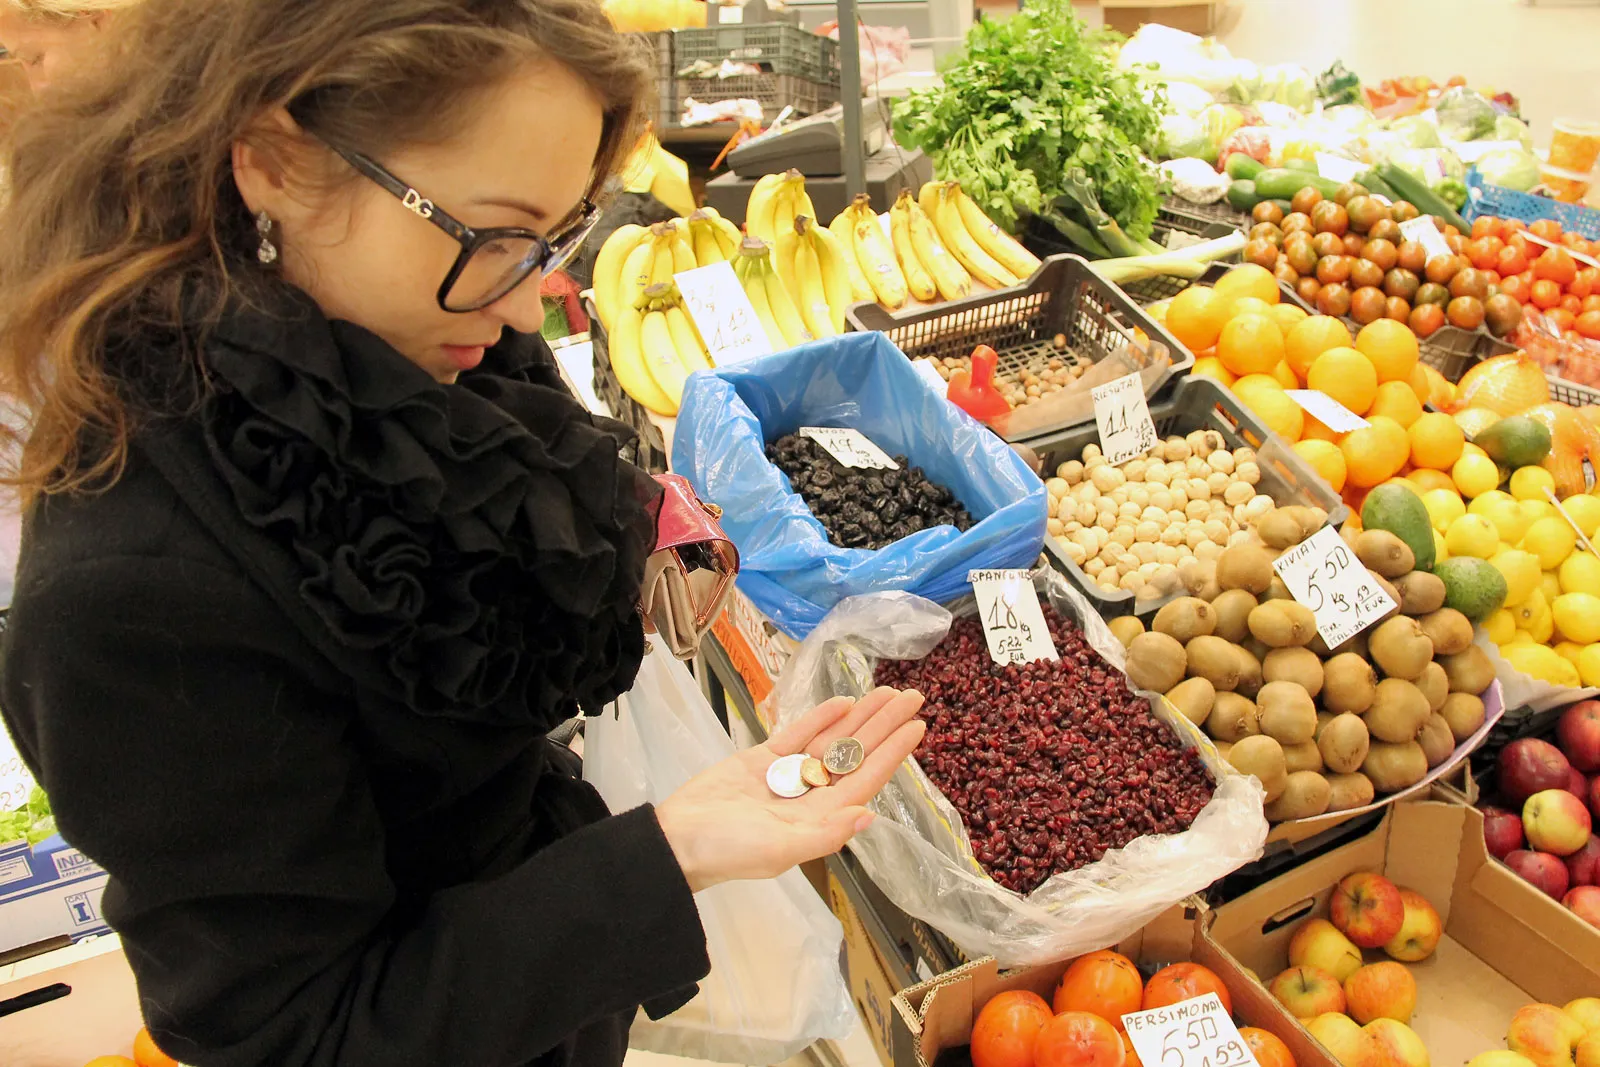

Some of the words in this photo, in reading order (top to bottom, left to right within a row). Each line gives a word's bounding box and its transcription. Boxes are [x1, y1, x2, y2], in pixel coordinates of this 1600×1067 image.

[402, 188, 434, 218] DG
[1277, 540, 1317, 572] KIVIAI
[1365, 596, 1387, 612] EUR
[1126, 1000, 1221, 1031] PERSIMONAI
